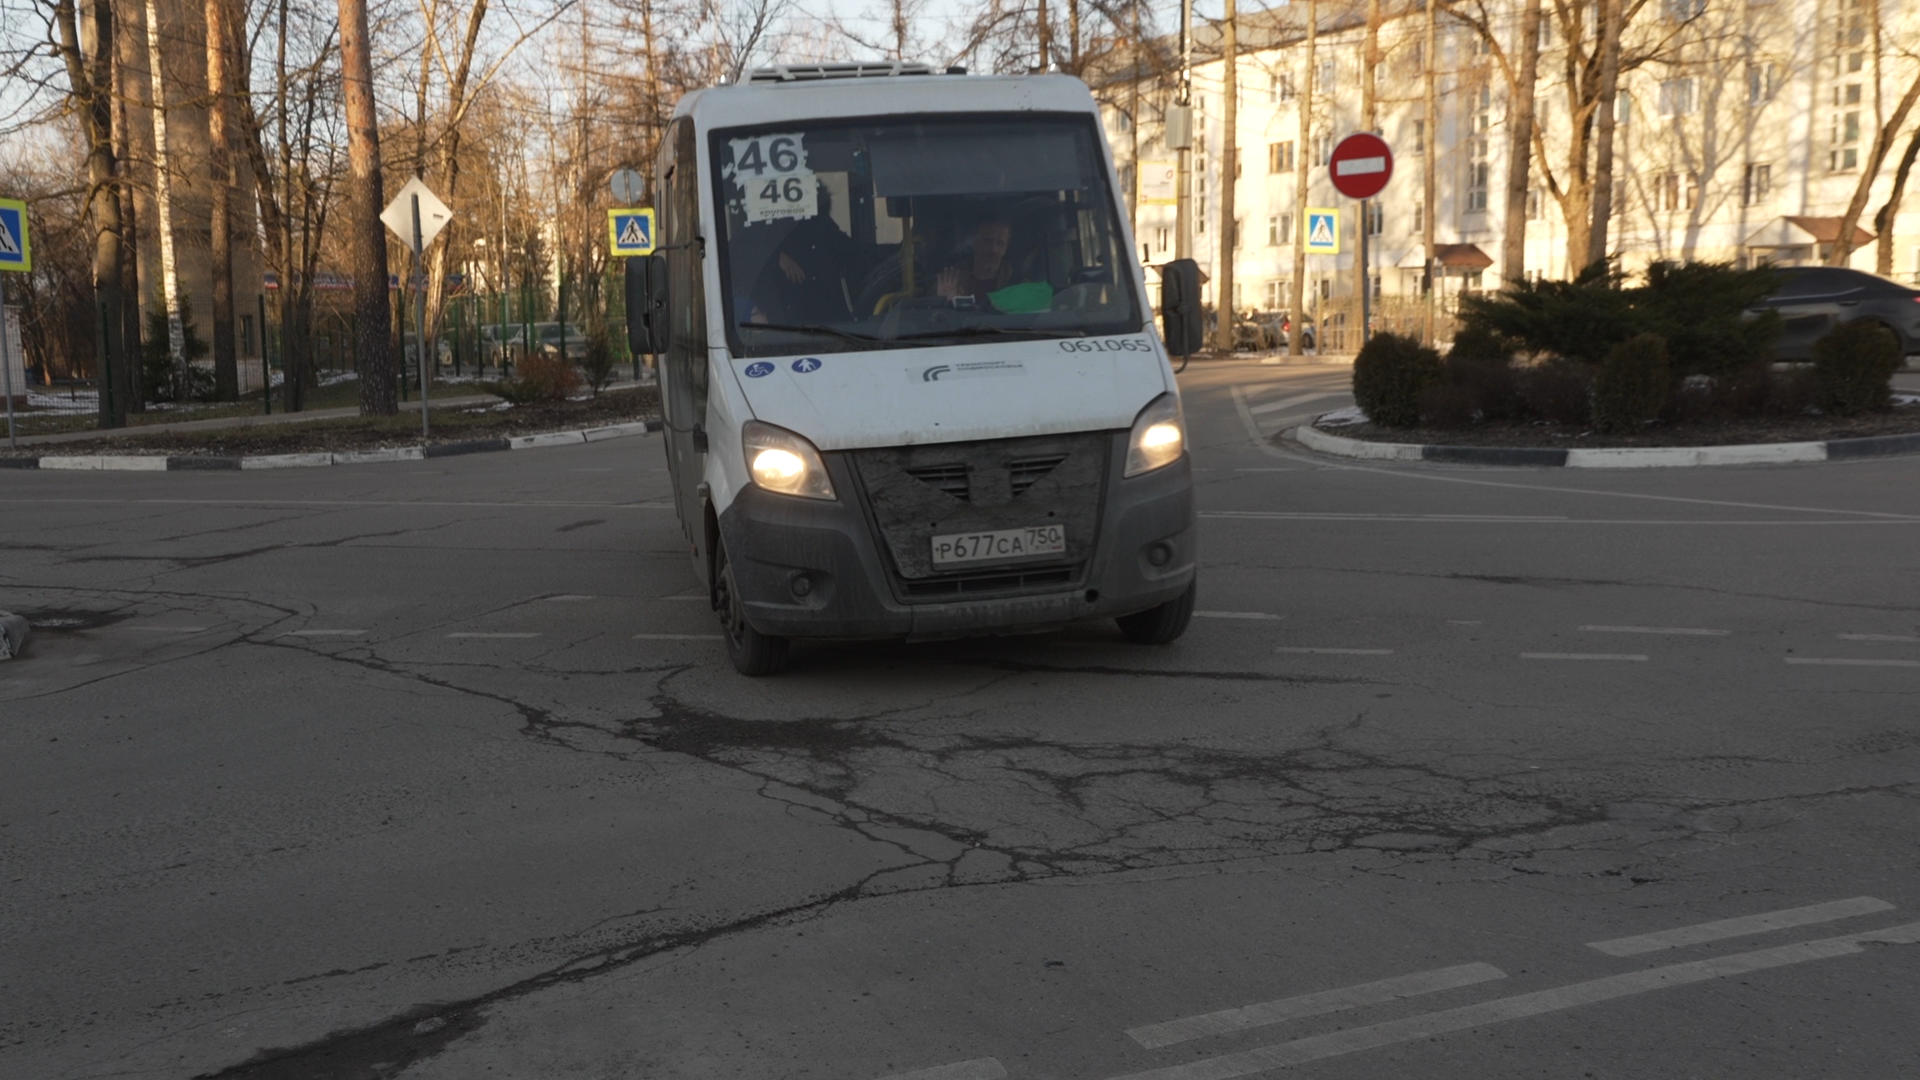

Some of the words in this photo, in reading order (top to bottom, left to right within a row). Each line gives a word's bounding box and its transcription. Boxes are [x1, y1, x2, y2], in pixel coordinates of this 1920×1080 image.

[737, 137, 798, 175] 46
[760, 177, 803, 204] 46
[1059, 339, 1152, 353] 061065
[1027, 527, 1059, 546] 750
